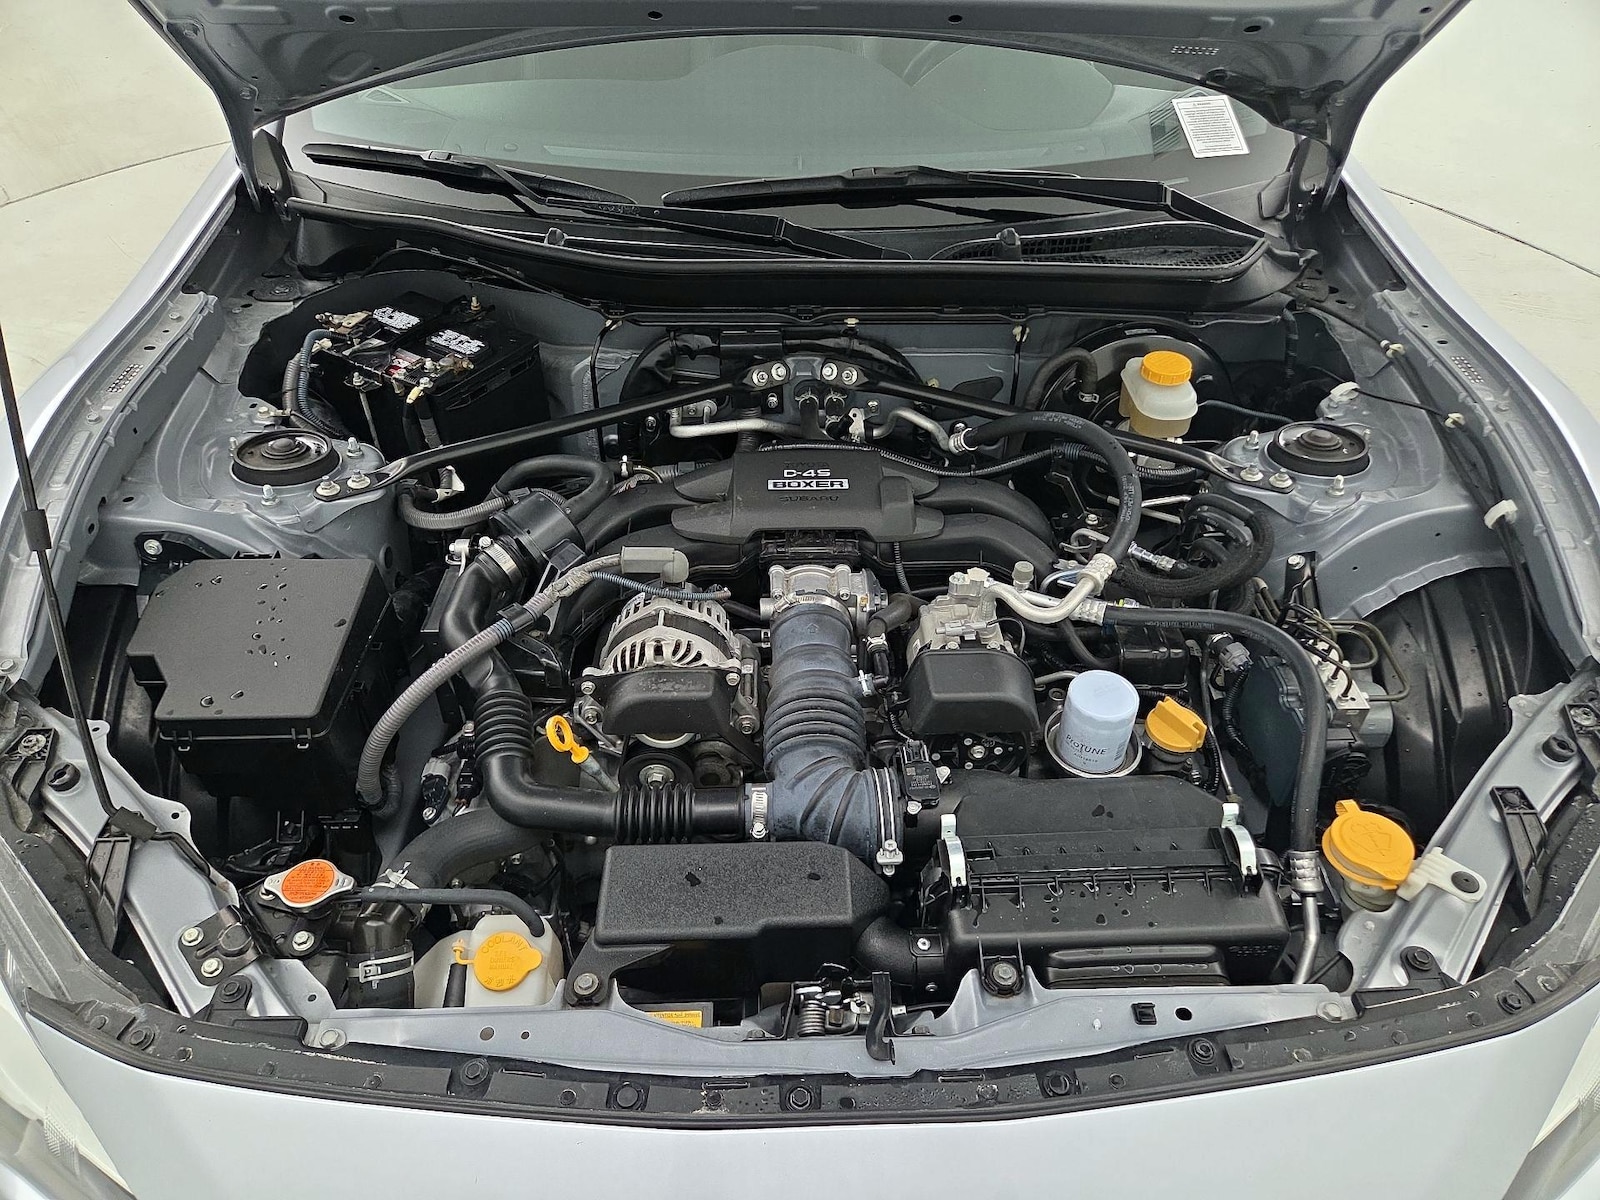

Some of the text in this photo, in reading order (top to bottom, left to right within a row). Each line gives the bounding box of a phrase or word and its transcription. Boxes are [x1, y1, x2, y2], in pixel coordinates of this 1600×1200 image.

[783, 469, 831, 478] D-4S
[772, 480, 844, 489] BOXER
[481, 936, 527, 953] COOLANT
